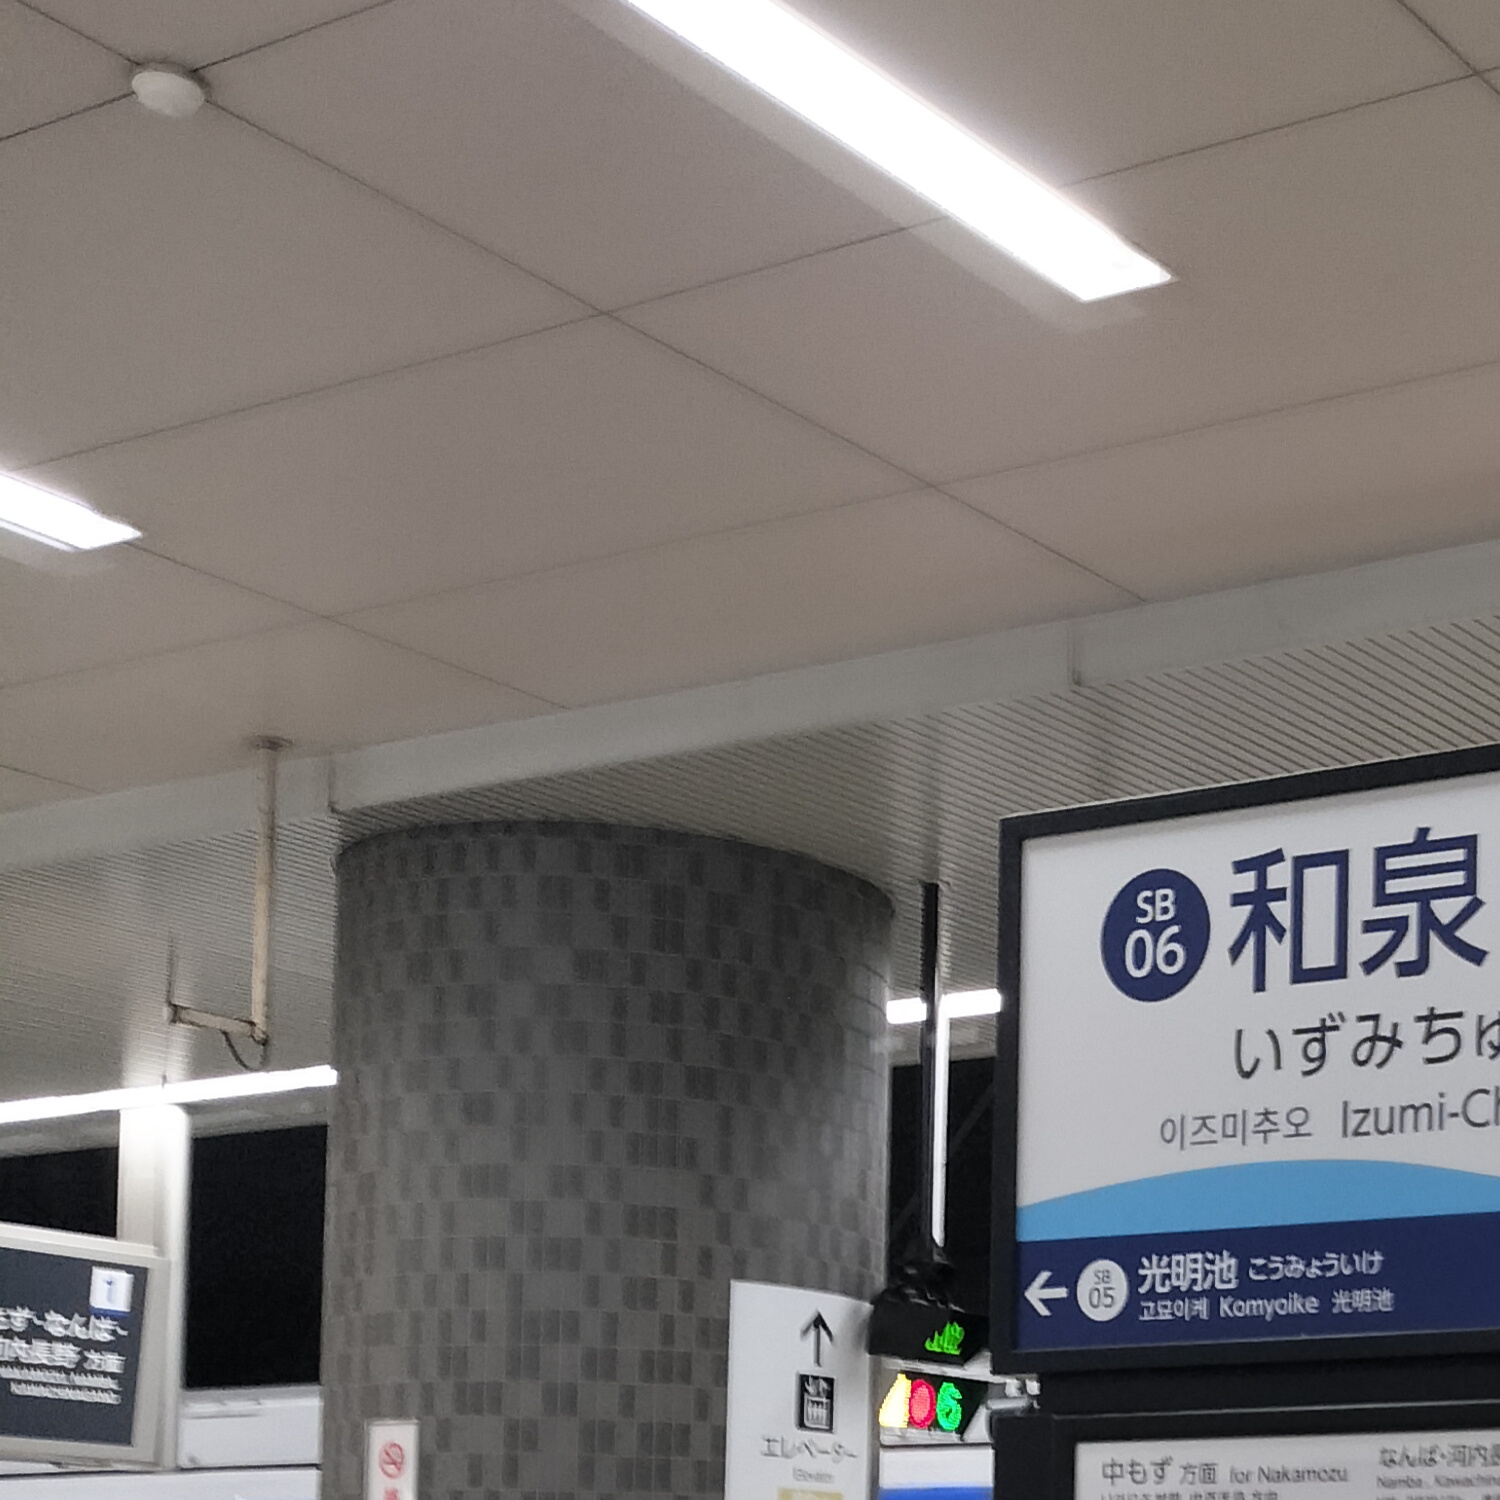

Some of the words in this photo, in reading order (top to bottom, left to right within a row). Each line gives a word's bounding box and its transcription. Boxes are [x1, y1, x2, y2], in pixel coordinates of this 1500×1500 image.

[1135, 890, 1177, 924] SB
[1122, 925, 1187, 979] 06
[1159, 1105, 1314, 1152] 이즈미추오
[1137, 1250, 1240, 1295] 光明池
[1248, 1250, 1385, 1282] こうみょういけ
[1088, 1286, 1115, 1309] 05
[1219, 1297, 1320, 1321] Komyoike
[1102, 1455, 1174, 1487] 中もず
[1179, 1463, 1219, 1485] 方面
